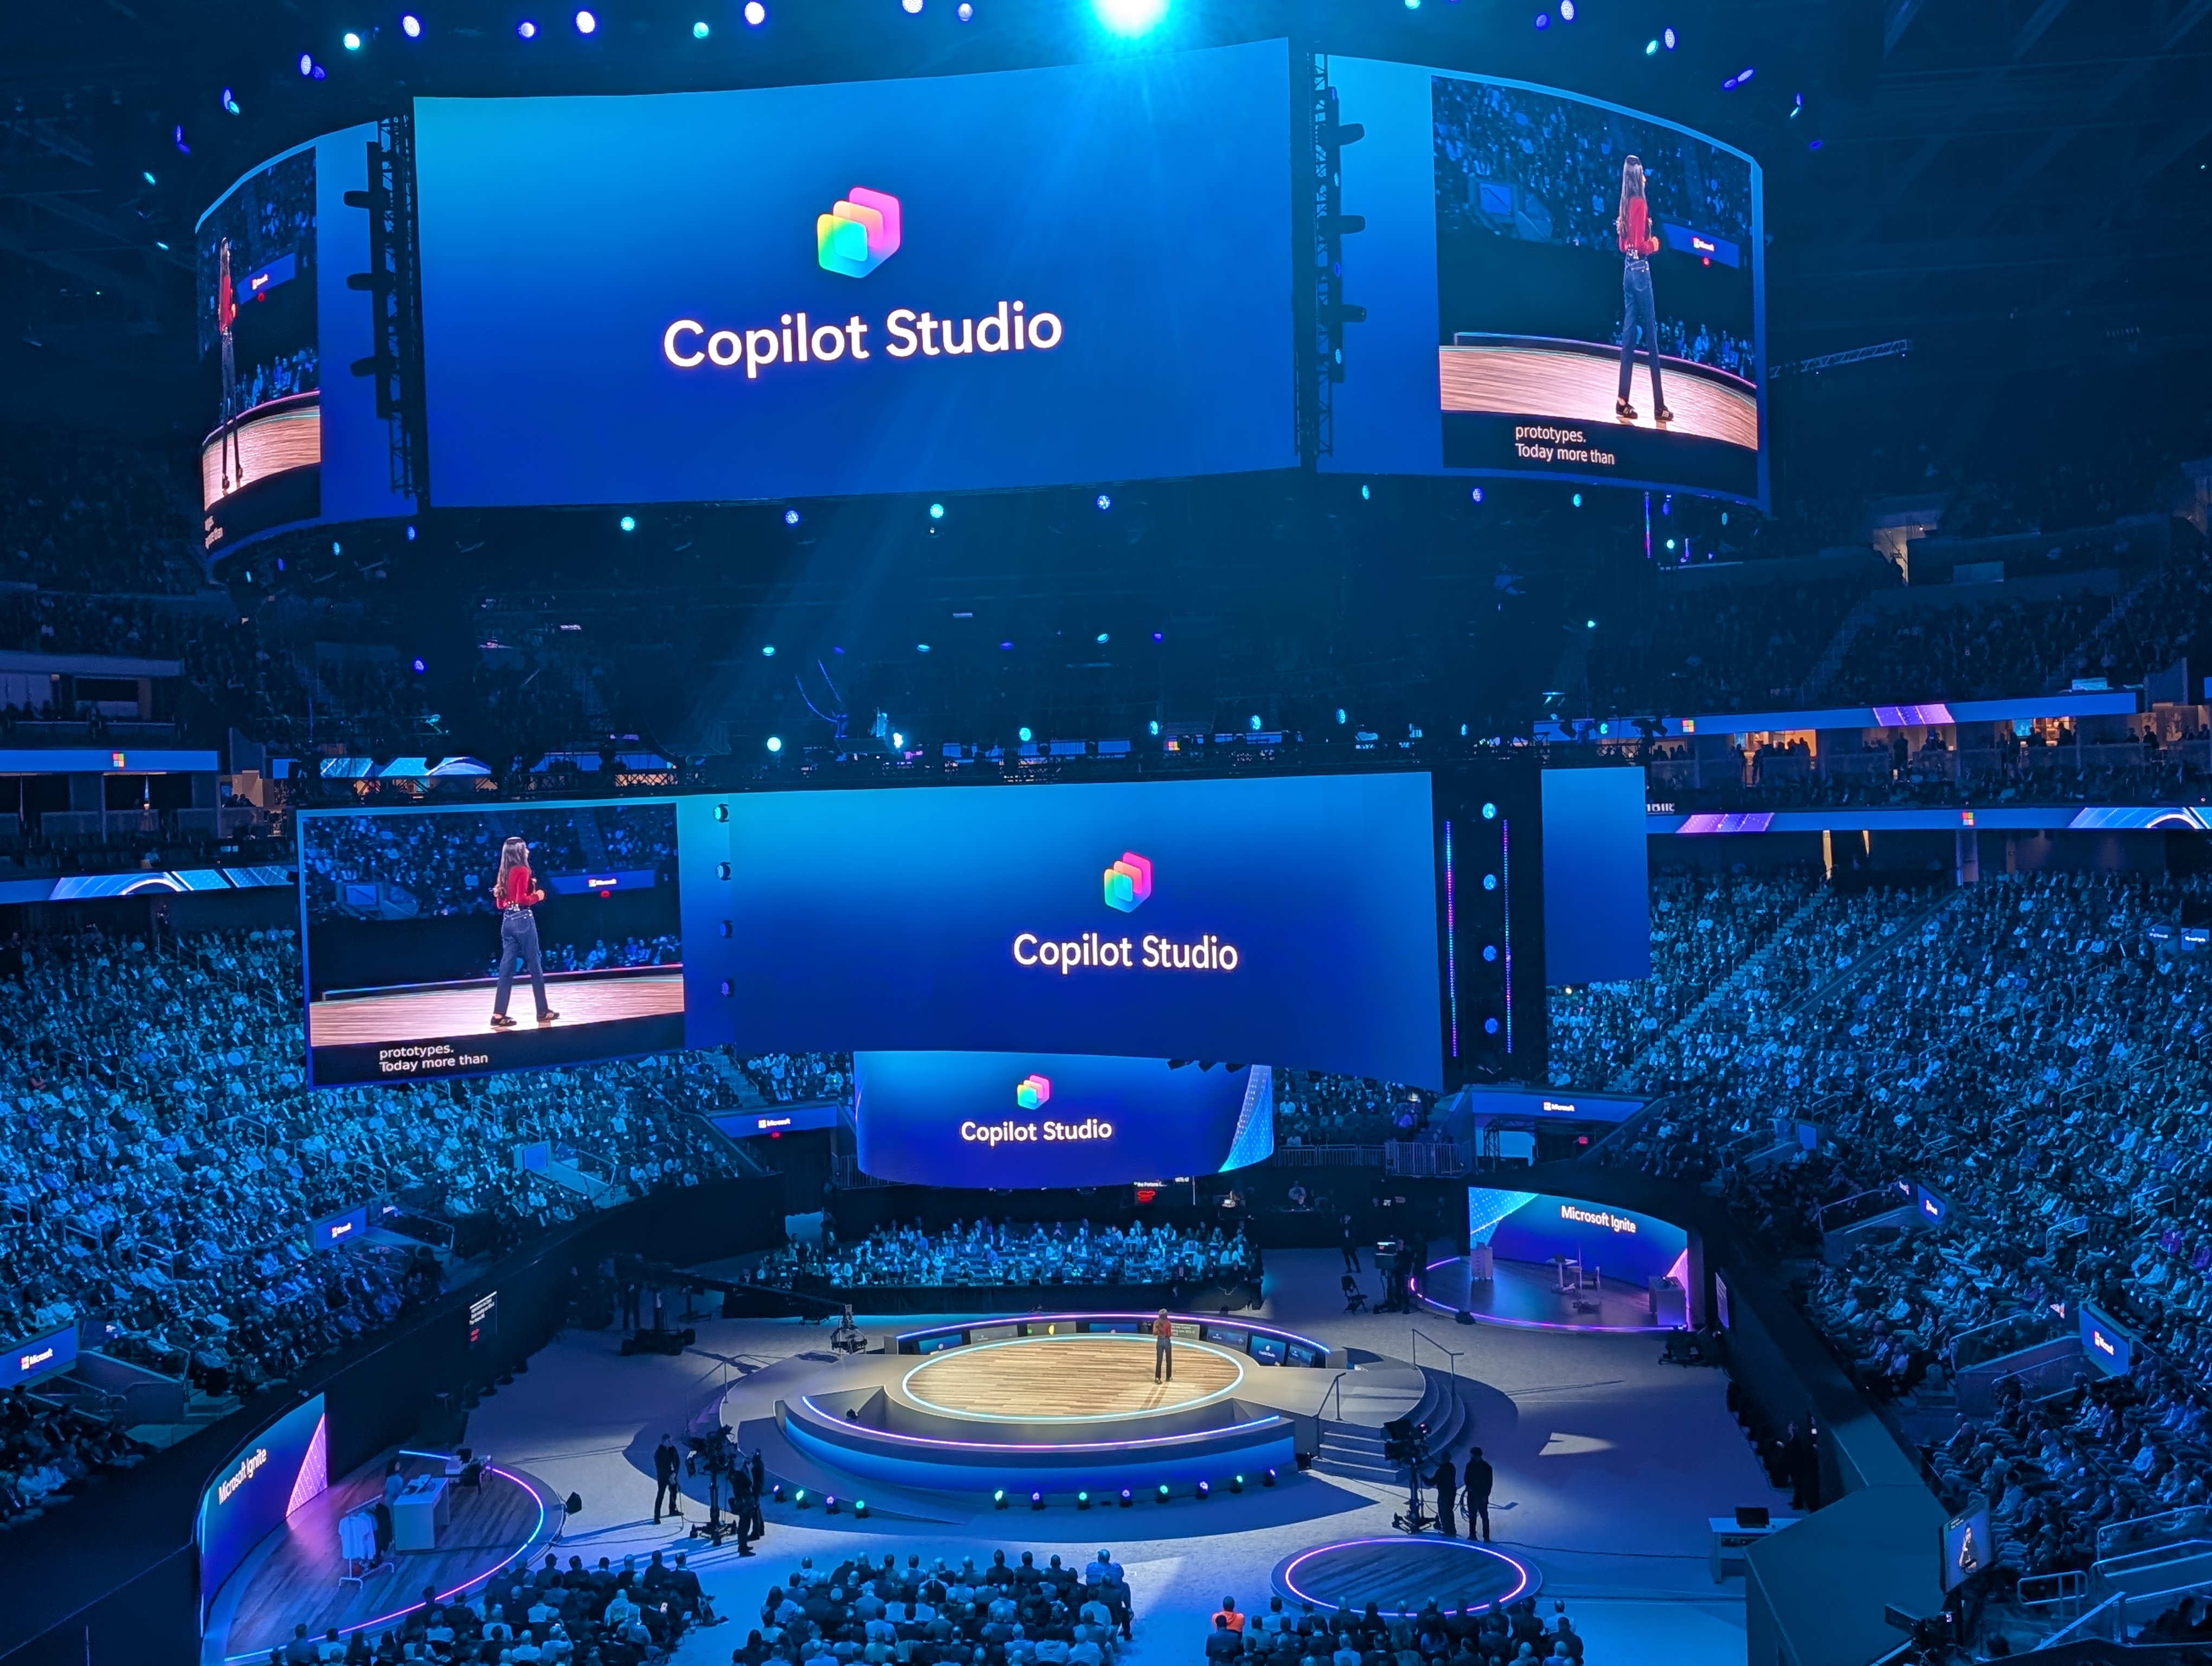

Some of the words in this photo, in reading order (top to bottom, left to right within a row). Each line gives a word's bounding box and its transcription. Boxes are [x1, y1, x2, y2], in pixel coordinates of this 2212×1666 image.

[664, 312, 869, 379] Copilot
[886, 300, 1062, 357] Studio
[1515, 426, 1586, 444] prototypes.
[1515, 443, 1554, 462] Today
[1557, 448, 1587, 462] more
[1590, 449, 1615, 465] than
[1014, 932, 1133, 975] Copilot
[1142, 934, 1238, 970] Studio
[379, 1060, 419, 1072] Today
[422, 1057, 456, 1069] more
[459, 1054, 488, 1066] than
[380, 1045, 454, 1061] prototypes.
[961, 1120, 1038, 1146] Copilot
[1043, 1119, 1112, 1140] Studio
[1561, 1205, 1610, 1227] Microsoft
[1611, 1215, 1636, 1233] Ignite
[218, 1461, 246, 1505] Microsoft
[246, 1448, 267, 1478] Ignite
